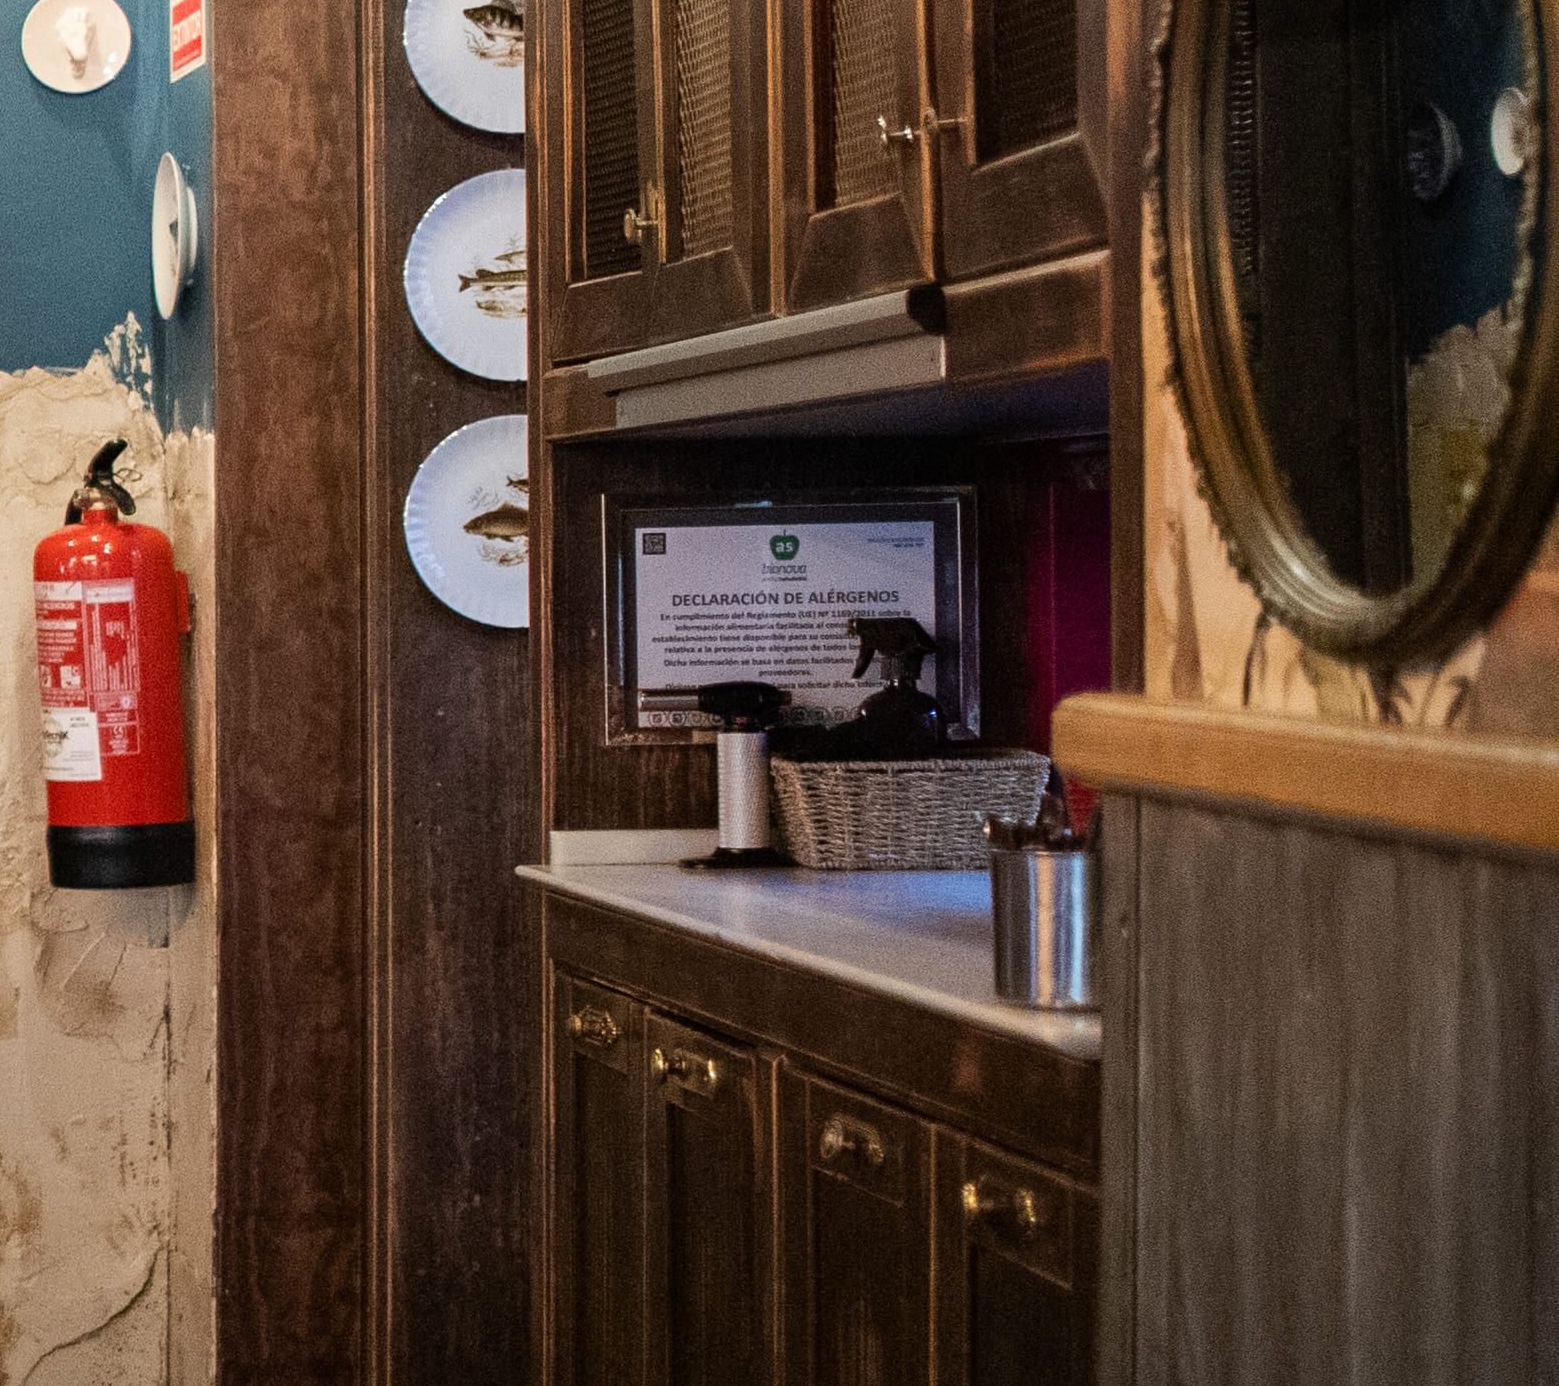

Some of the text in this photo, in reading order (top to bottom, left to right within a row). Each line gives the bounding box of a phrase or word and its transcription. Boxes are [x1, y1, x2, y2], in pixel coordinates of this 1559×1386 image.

[672, 588, 900, 606] DECLARACIÓN DE ALÉRGENOS
